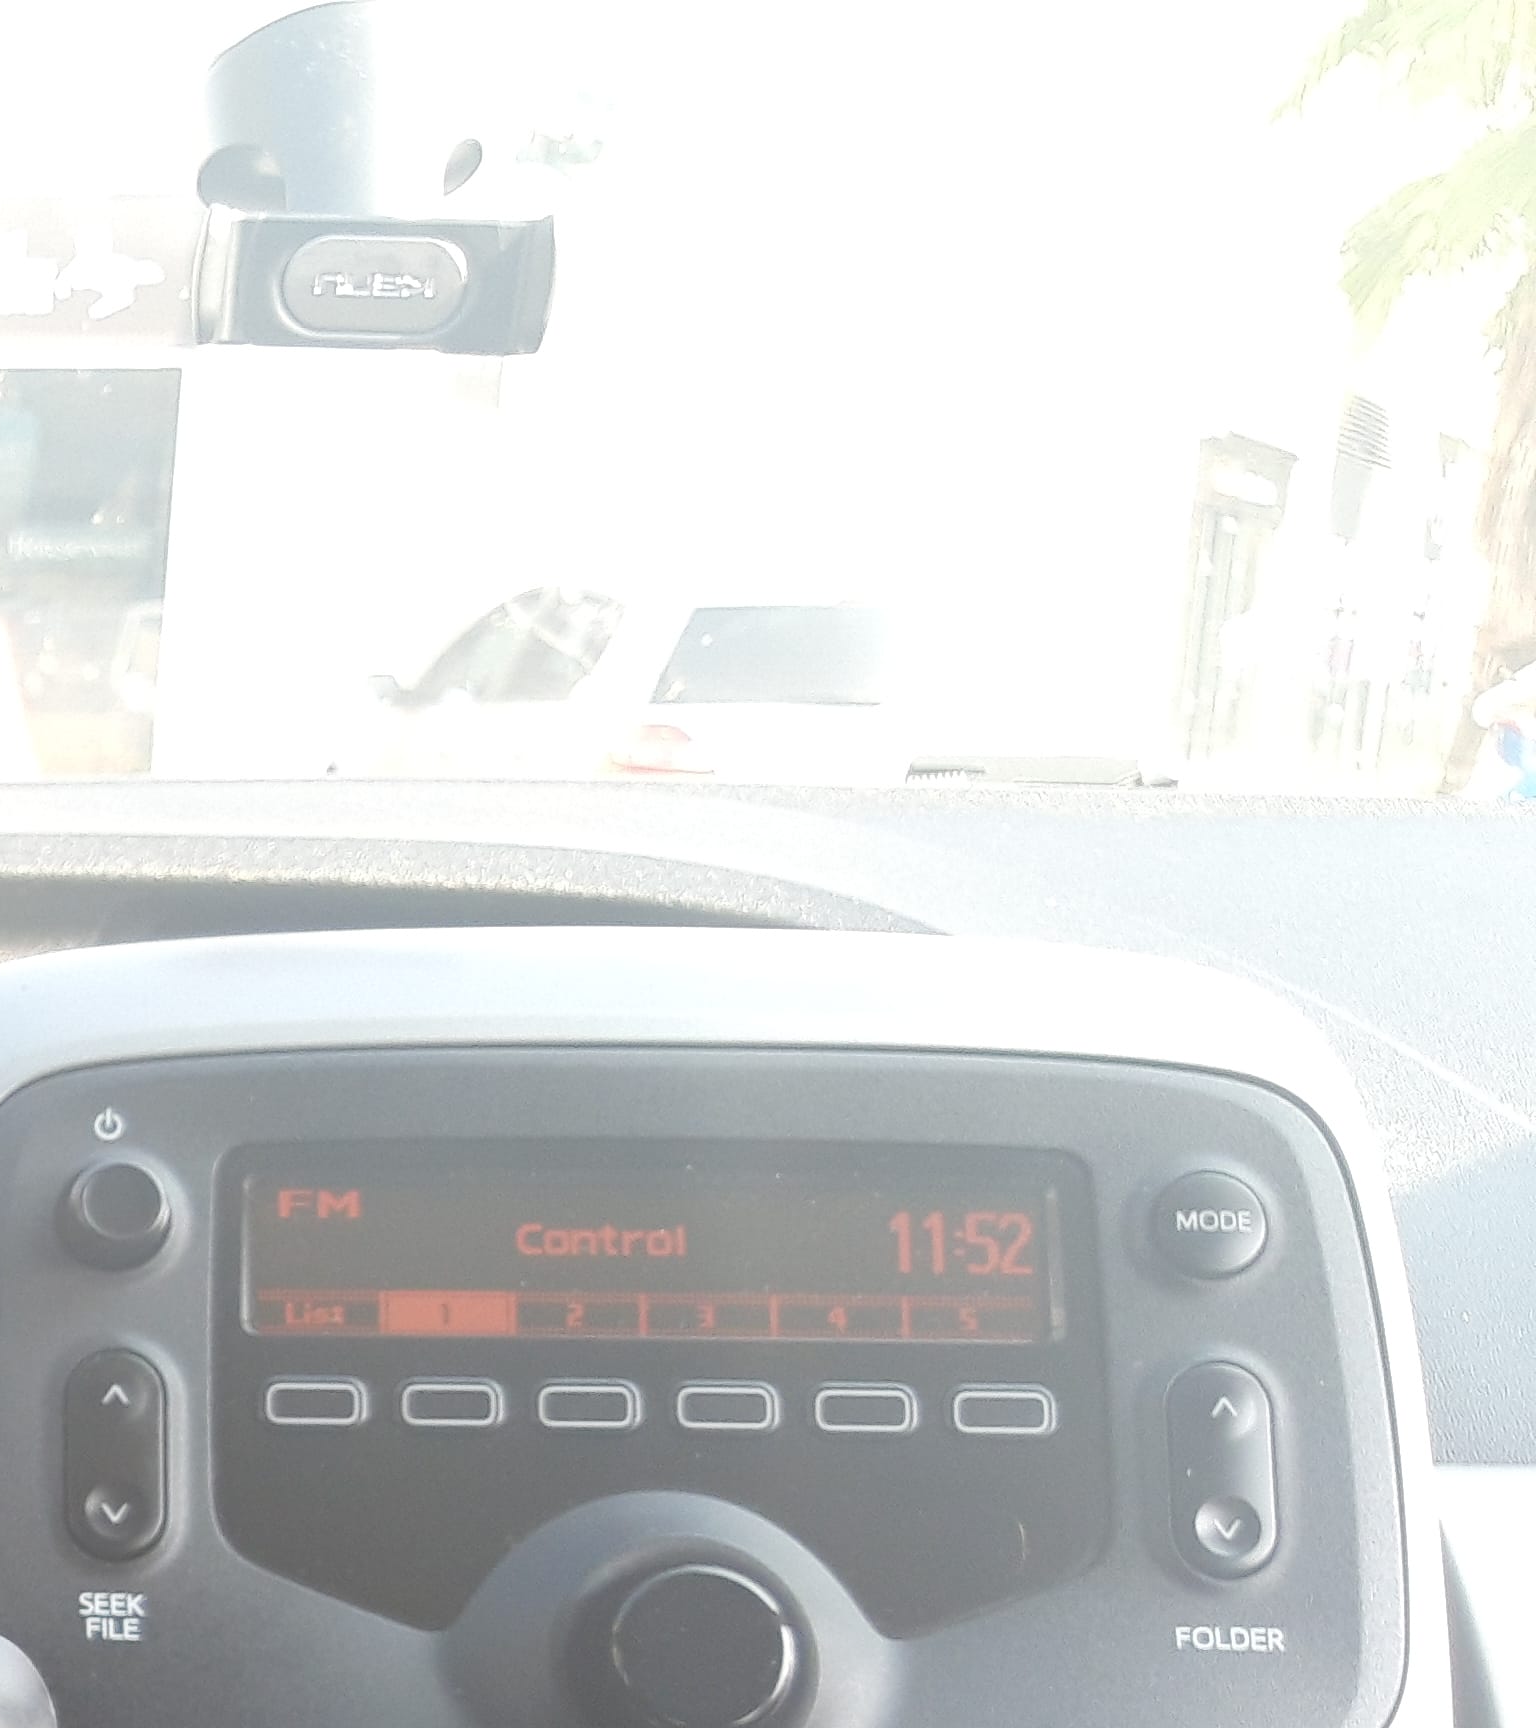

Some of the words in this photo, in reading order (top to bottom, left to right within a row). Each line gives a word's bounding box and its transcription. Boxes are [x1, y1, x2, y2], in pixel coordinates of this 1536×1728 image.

[277, 1189, 363, 1220] FM
[1175, 1209, 1254, 1233] MODE
[515, 1222, 688, 1257] Control
[888, 1210, 1034, 1276] 11:52
[564, 1303, 586, 1329] 2
[699, 1304, 716, 1330] 3
[78, 1591, 147, 1617] SEEK
[85, 1616, 142, 1642] FILE
[1174, 1625, 1286, 1653] FOLDER
